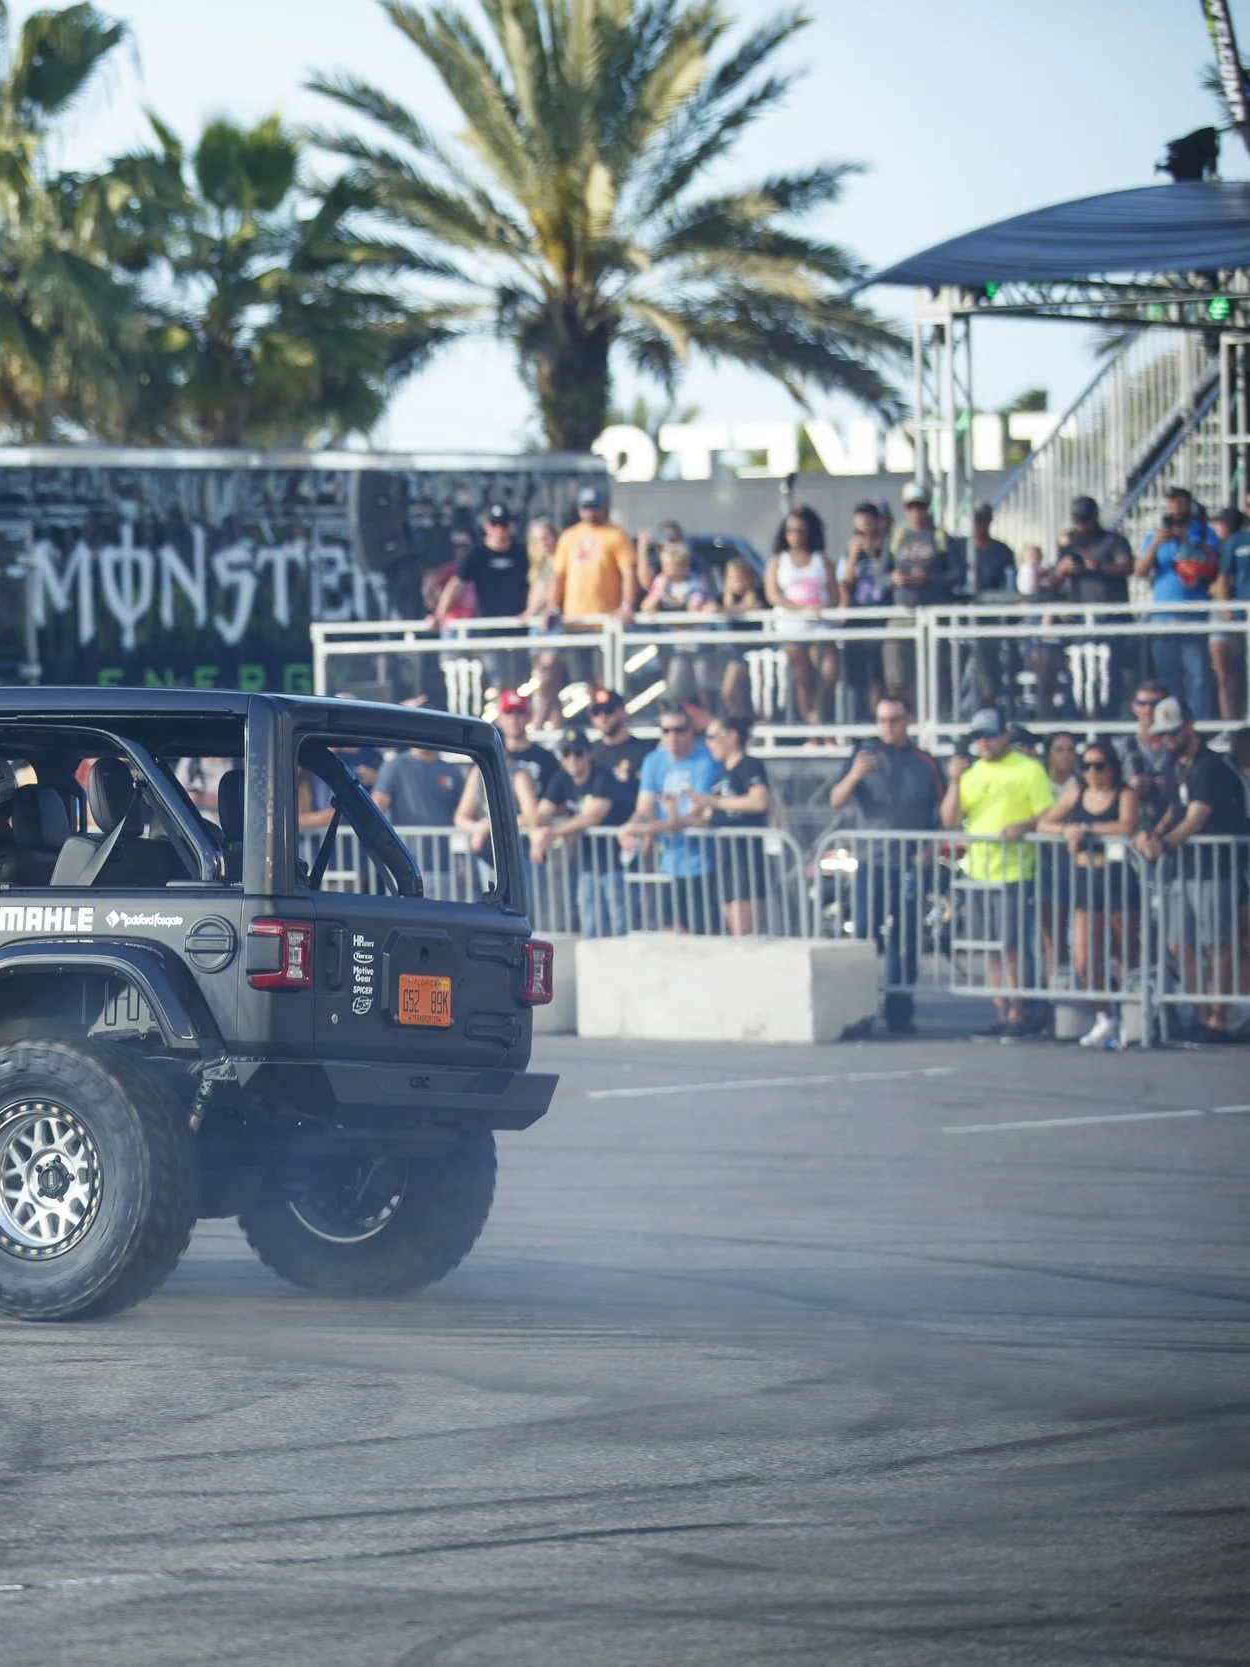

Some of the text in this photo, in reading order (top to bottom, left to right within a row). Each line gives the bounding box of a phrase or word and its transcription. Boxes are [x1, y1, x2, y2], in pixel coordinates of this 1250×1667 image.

[353, 966, 374, 976] Motive
[355, 974, 371, 983] Gear
[353, 985, 373, 995] SPICER
[403, 989, 449, 1015] G52 89K
